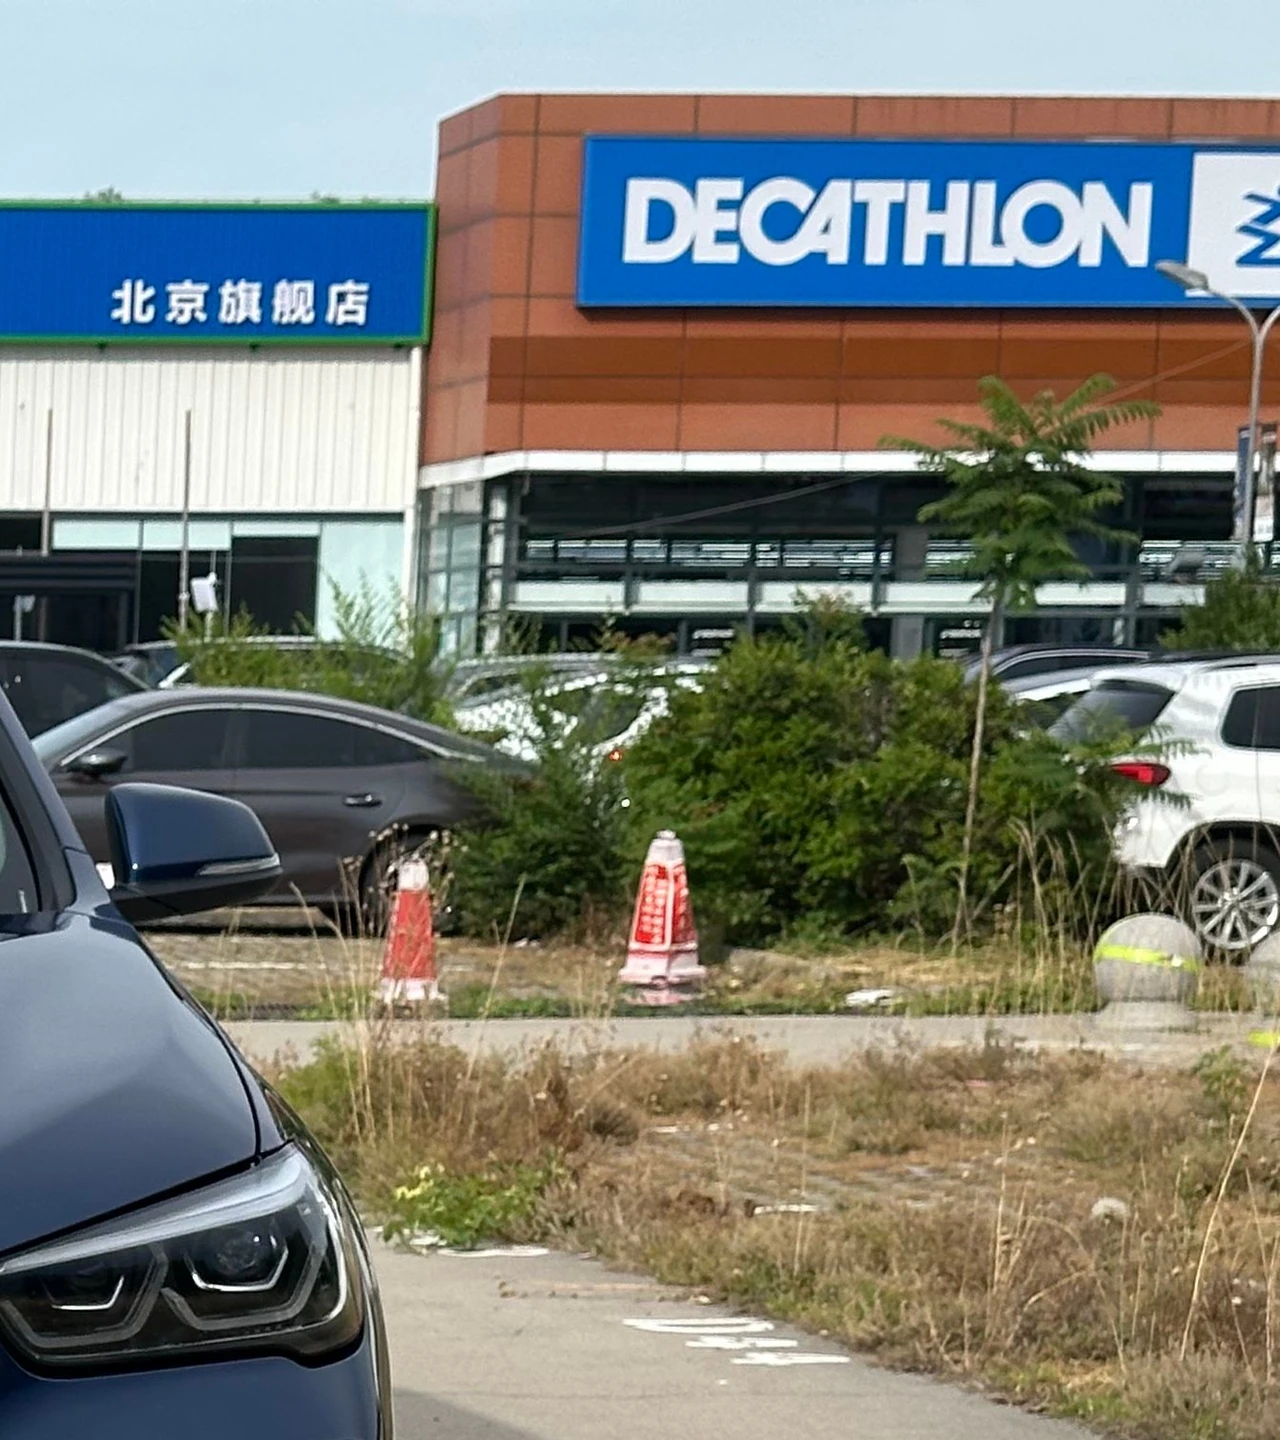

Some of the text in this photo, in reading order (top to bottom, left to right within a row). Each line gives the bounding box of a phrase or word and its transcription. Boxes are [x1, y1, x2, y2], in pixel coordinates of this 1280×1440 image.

[622, 177, 1153, 268] DECATHLON
[110, 278, 371, 325] 北京旗舰店
